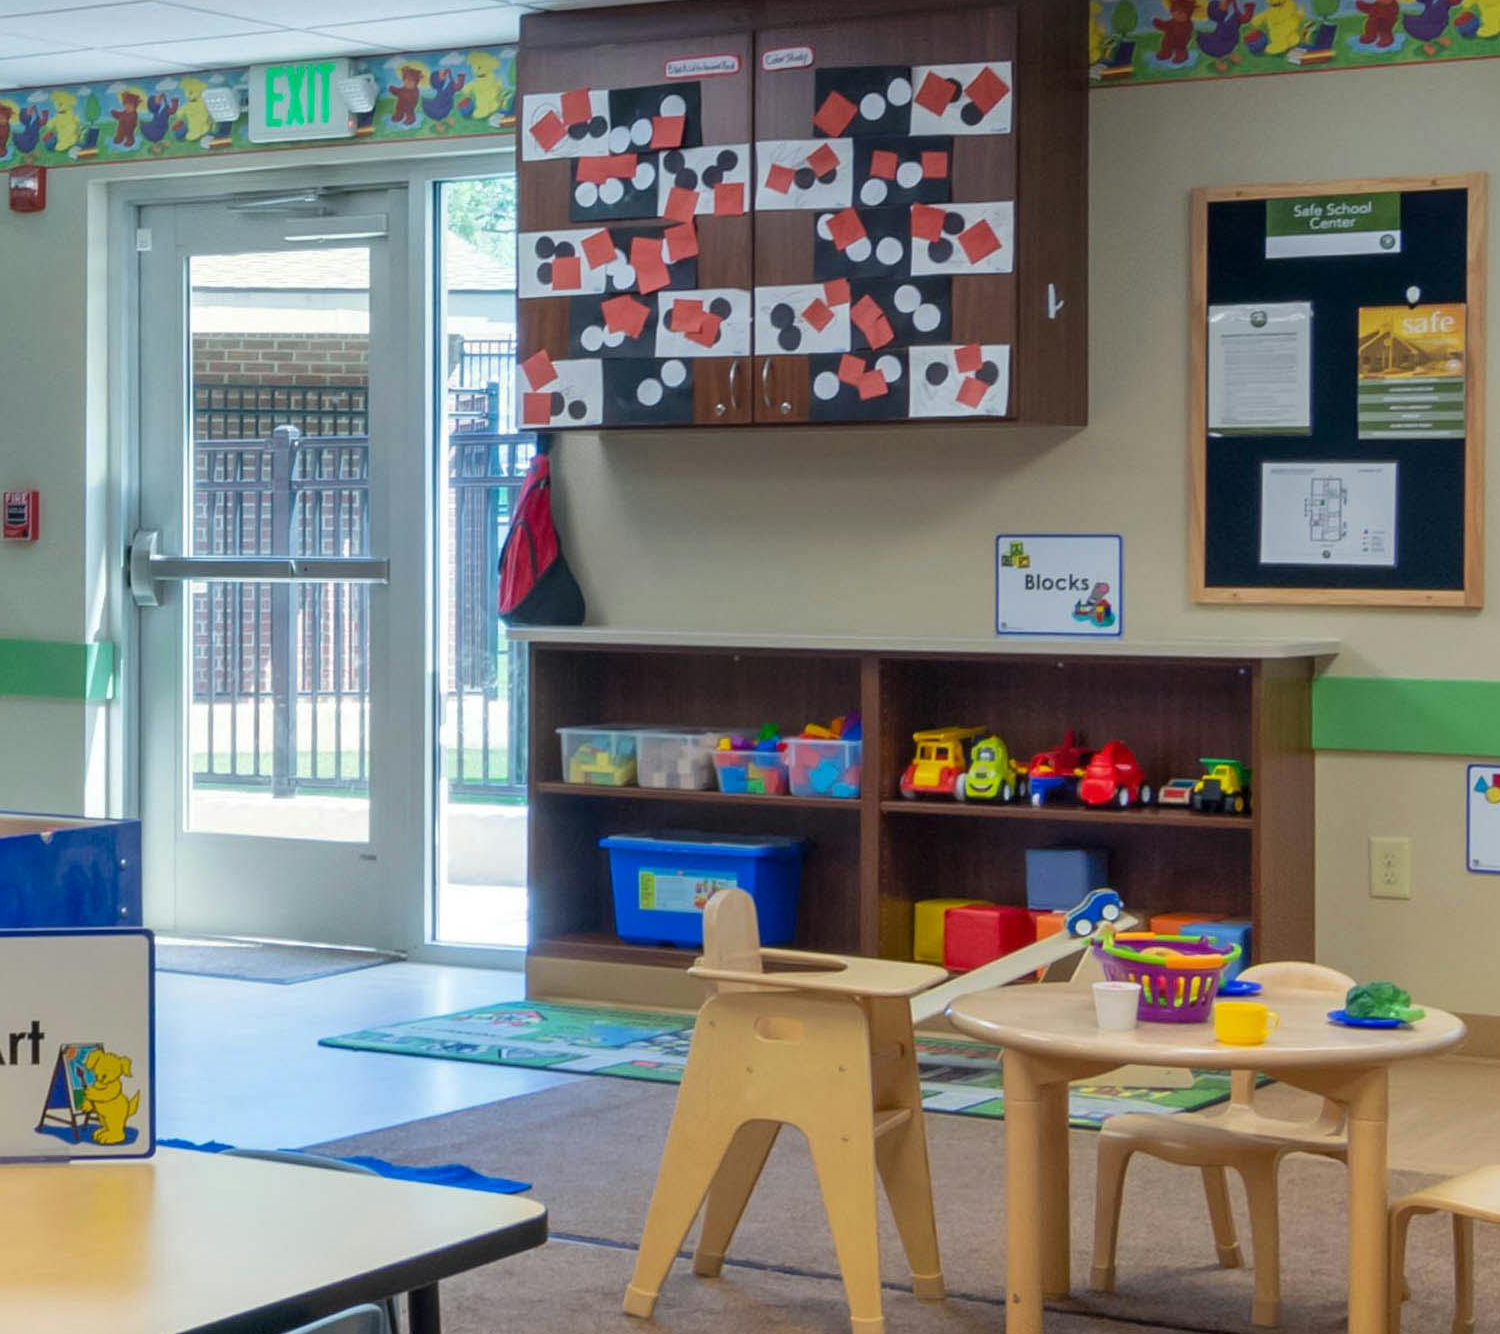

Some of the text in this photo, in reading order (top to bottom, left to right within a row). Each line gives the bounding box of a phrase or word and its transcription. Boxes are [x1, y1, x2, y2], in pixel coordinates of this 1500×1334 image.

[265, 62, 336, 127] EXIT
[1293, 200, 1372, 218] Safe School
[1309, 216, 1356, 230] Center
[1402, 310, 1456, 334] safe
[1024, 573, 1090, 591] Blocks
